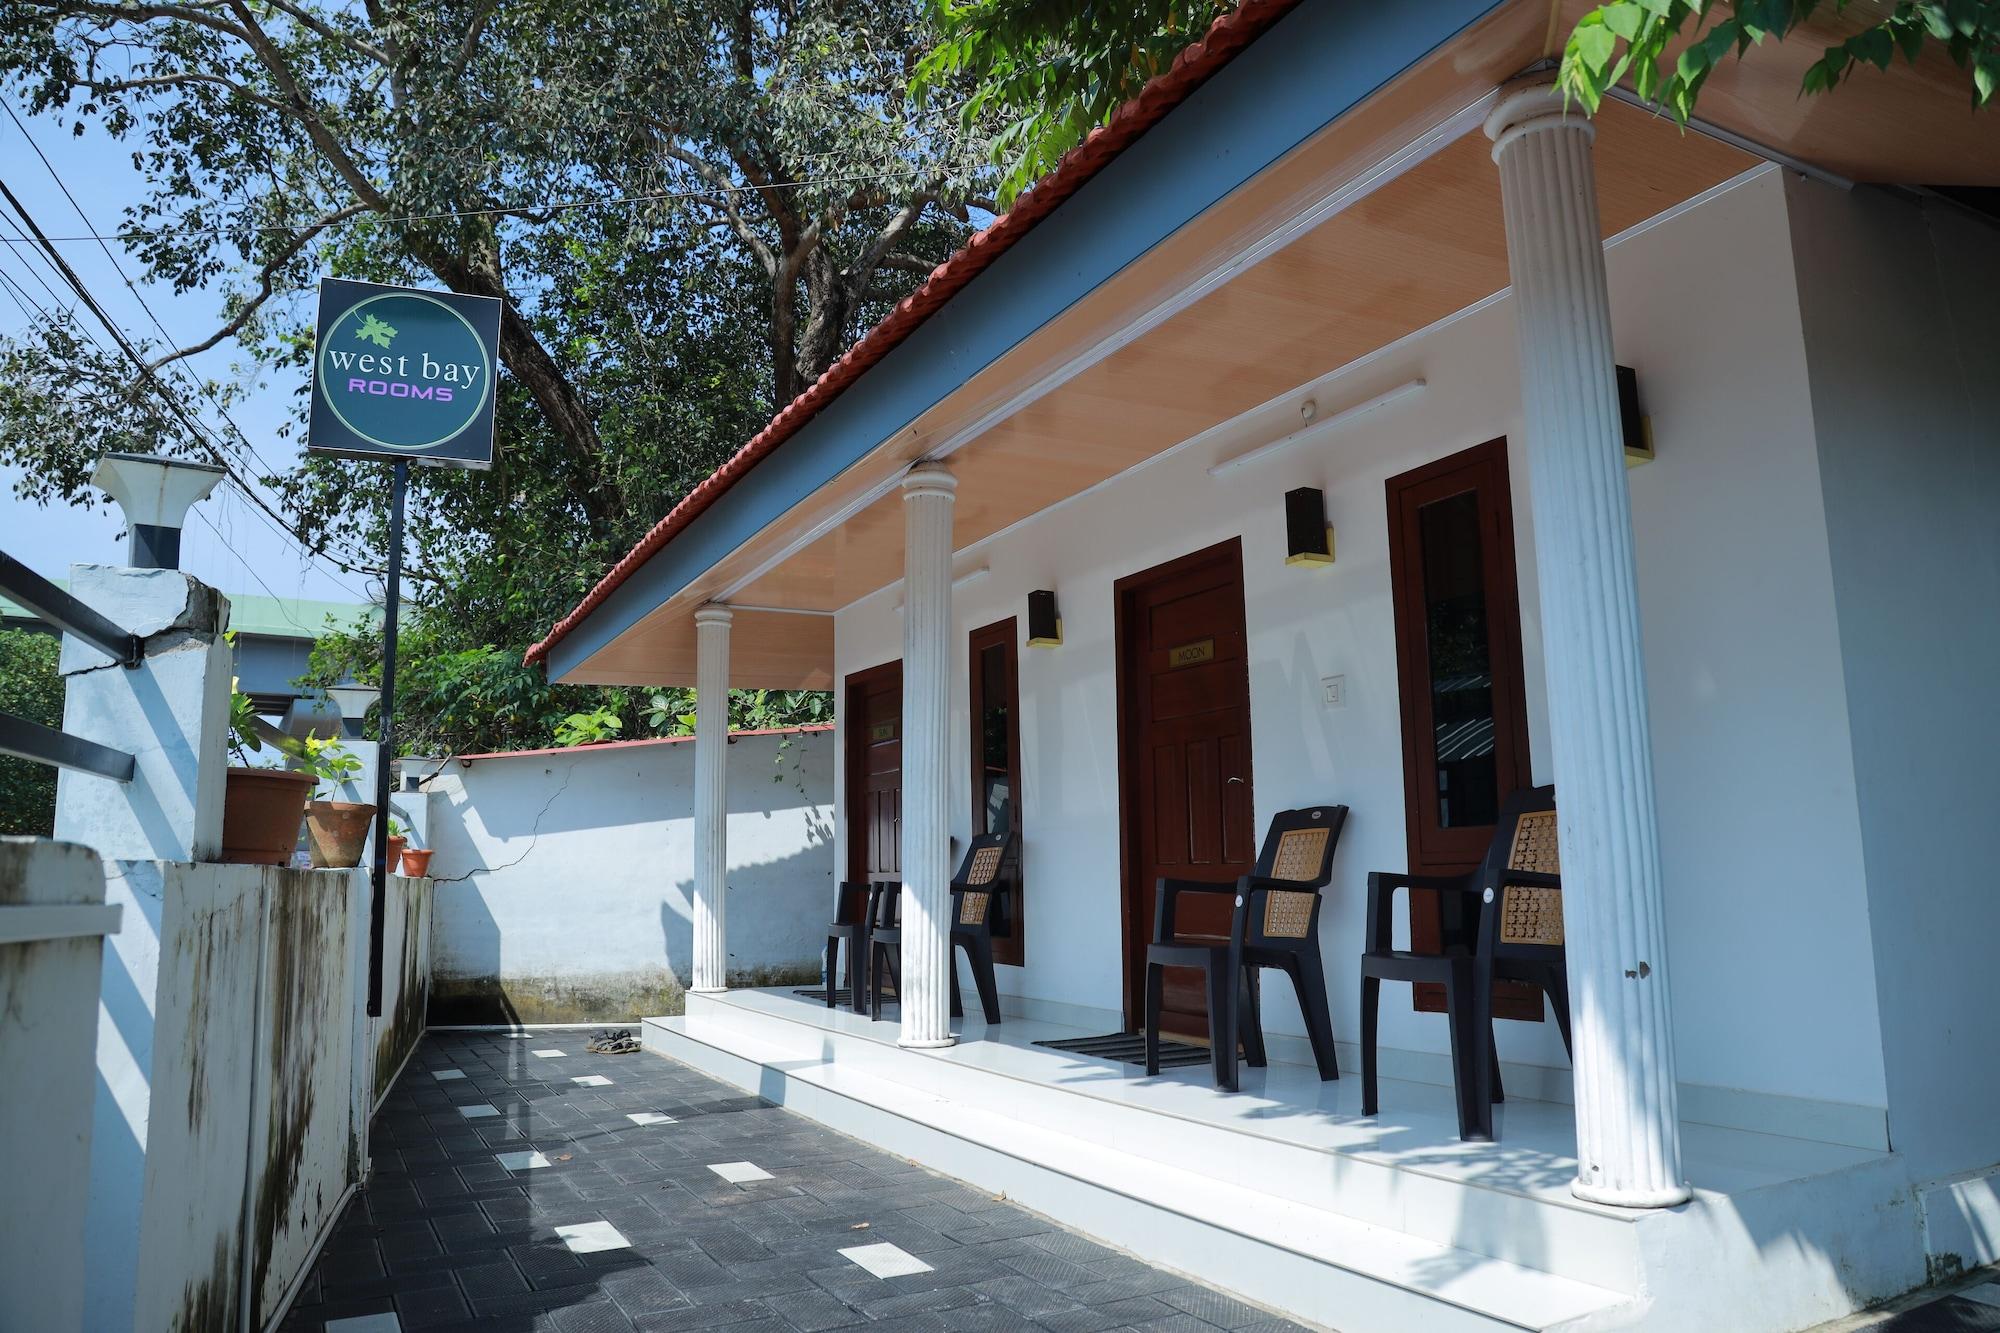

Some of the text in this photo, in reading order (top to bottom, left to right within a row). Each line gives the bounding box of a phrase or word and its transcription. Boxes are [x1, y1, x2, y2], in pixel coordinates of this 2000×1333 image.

[328, 350, 481, 390] west bay
[348, 377, 453, 402] ROOMS
[1177, 646, 1205, 661] MOON
